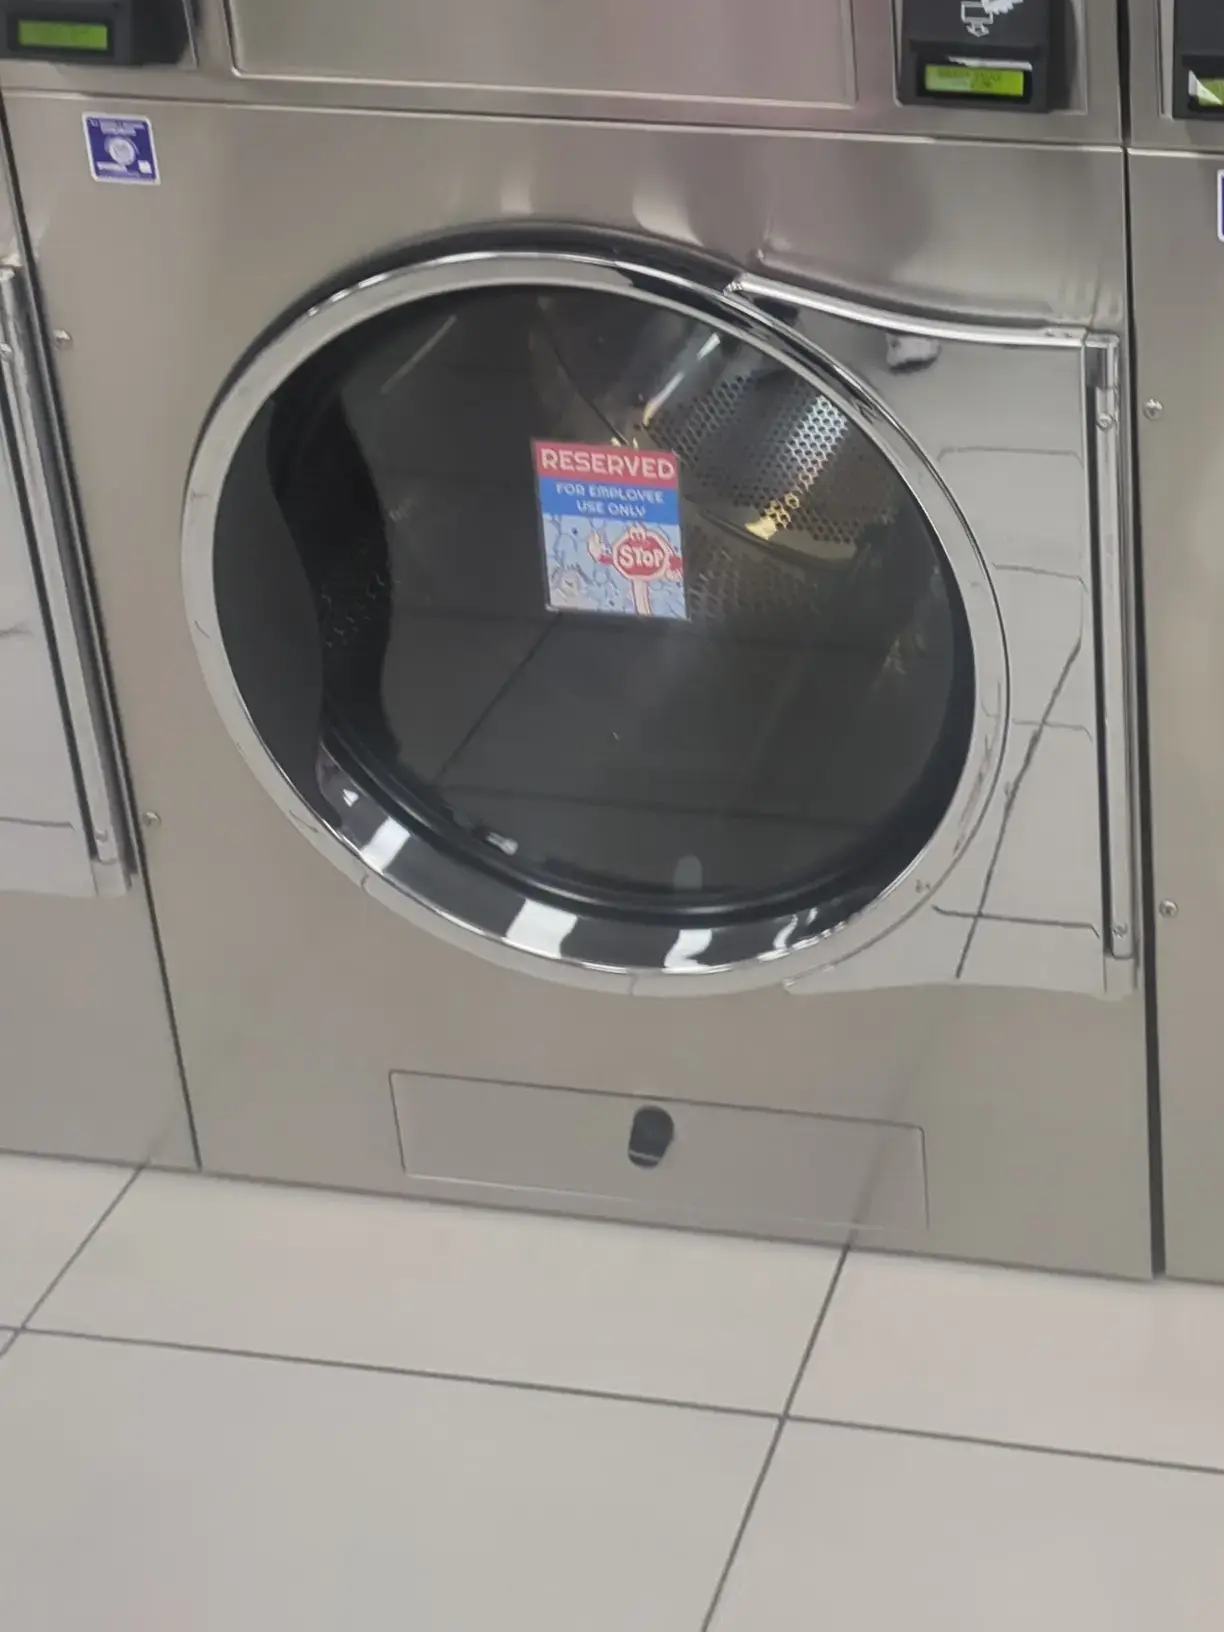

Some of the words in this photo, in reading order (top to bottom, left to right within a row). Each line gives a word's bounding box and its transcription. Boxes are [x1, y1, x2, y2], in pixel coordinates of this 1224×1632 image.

[540, 448, 675, 480] RESERVED
[556, 483, 585, 495] FOR
[589, 484, 664, 504] EMPLOYEE
[576, 500, 604, 514] USE
[608, 502, 647, 517] ONLY
